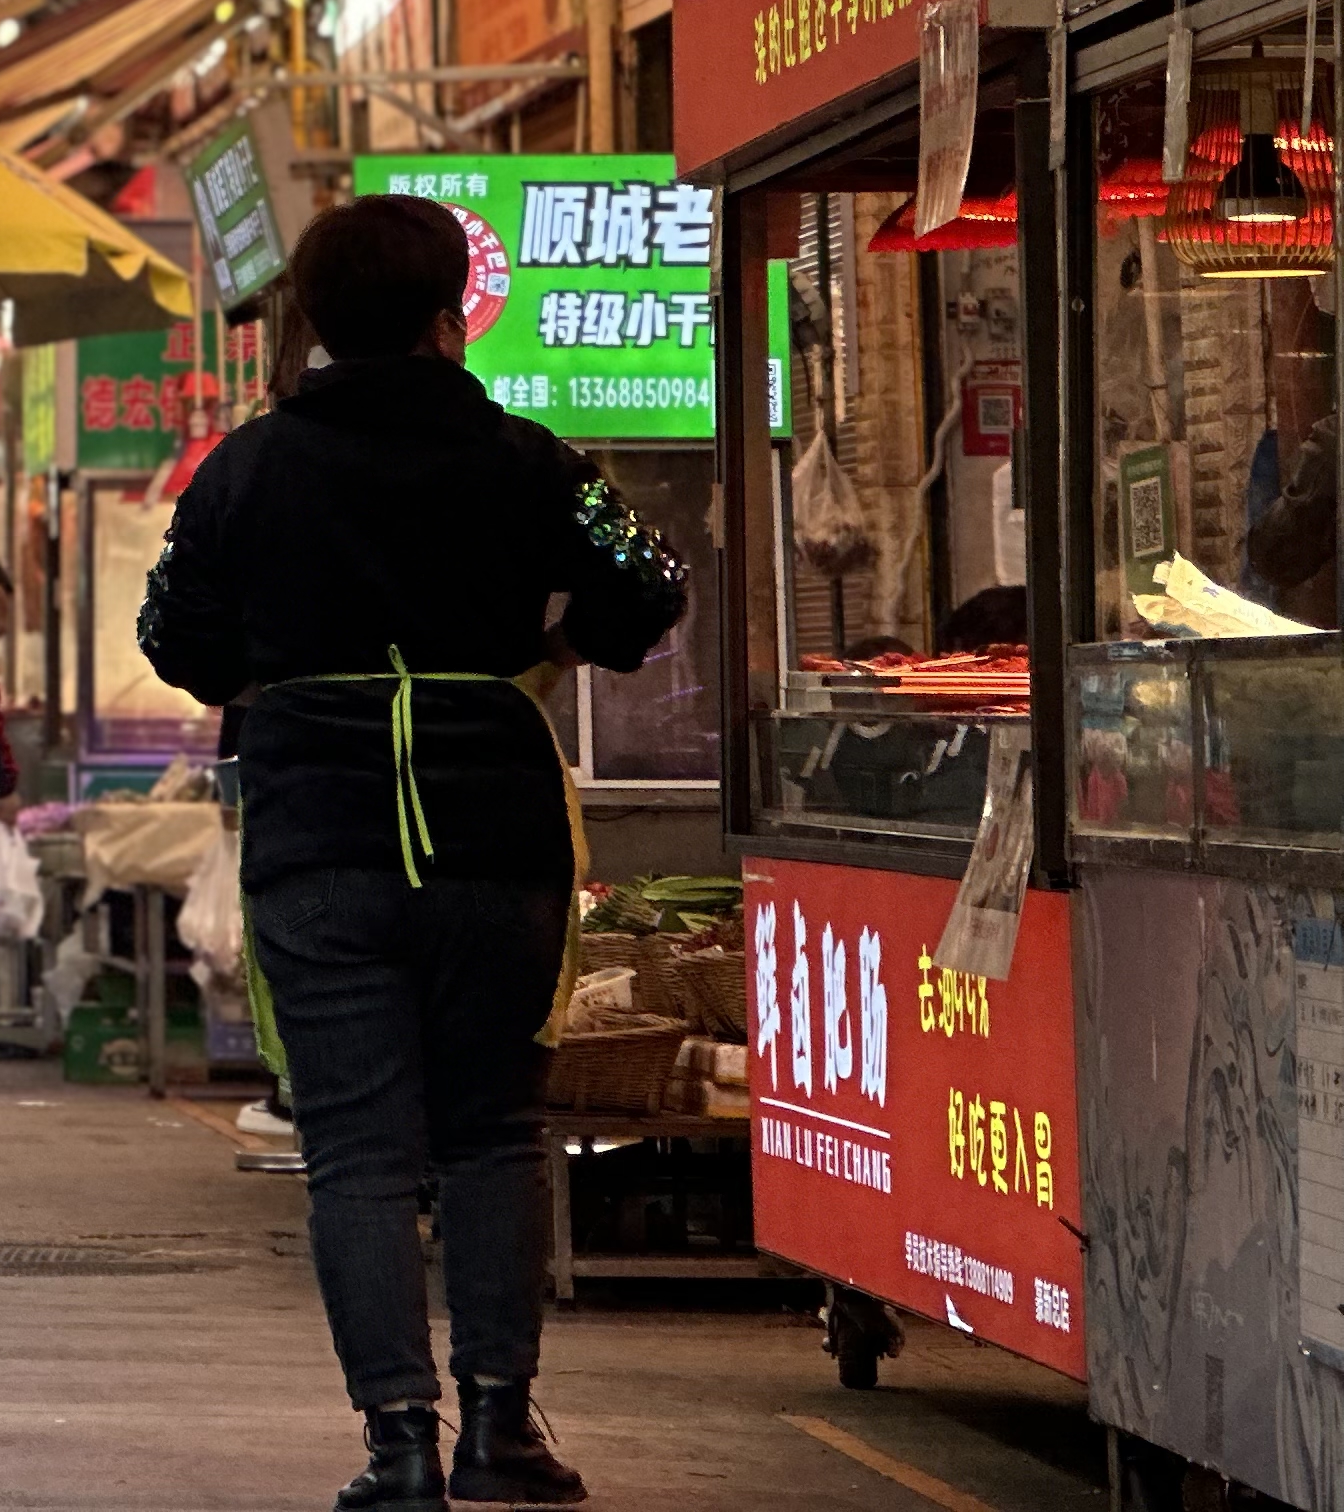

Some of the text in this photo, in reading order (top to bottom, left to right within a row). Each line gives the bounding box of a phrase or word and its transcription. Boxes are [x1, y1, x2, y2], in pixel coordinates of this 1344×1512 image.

[388, 173, 489, 199] 版权所有
[518, 182, 713, 266] 顺城老
[539, 291, 715, 347] 特级小干
[568, 377, 710, 409] 13368850984
[754, 898, 888, 1109] 鲜卤肥肠
[761, 1116, 892, 1195] XIAN LU FEI CHANG
[948, 1086, 1054, 1211] 好吃更入胃
